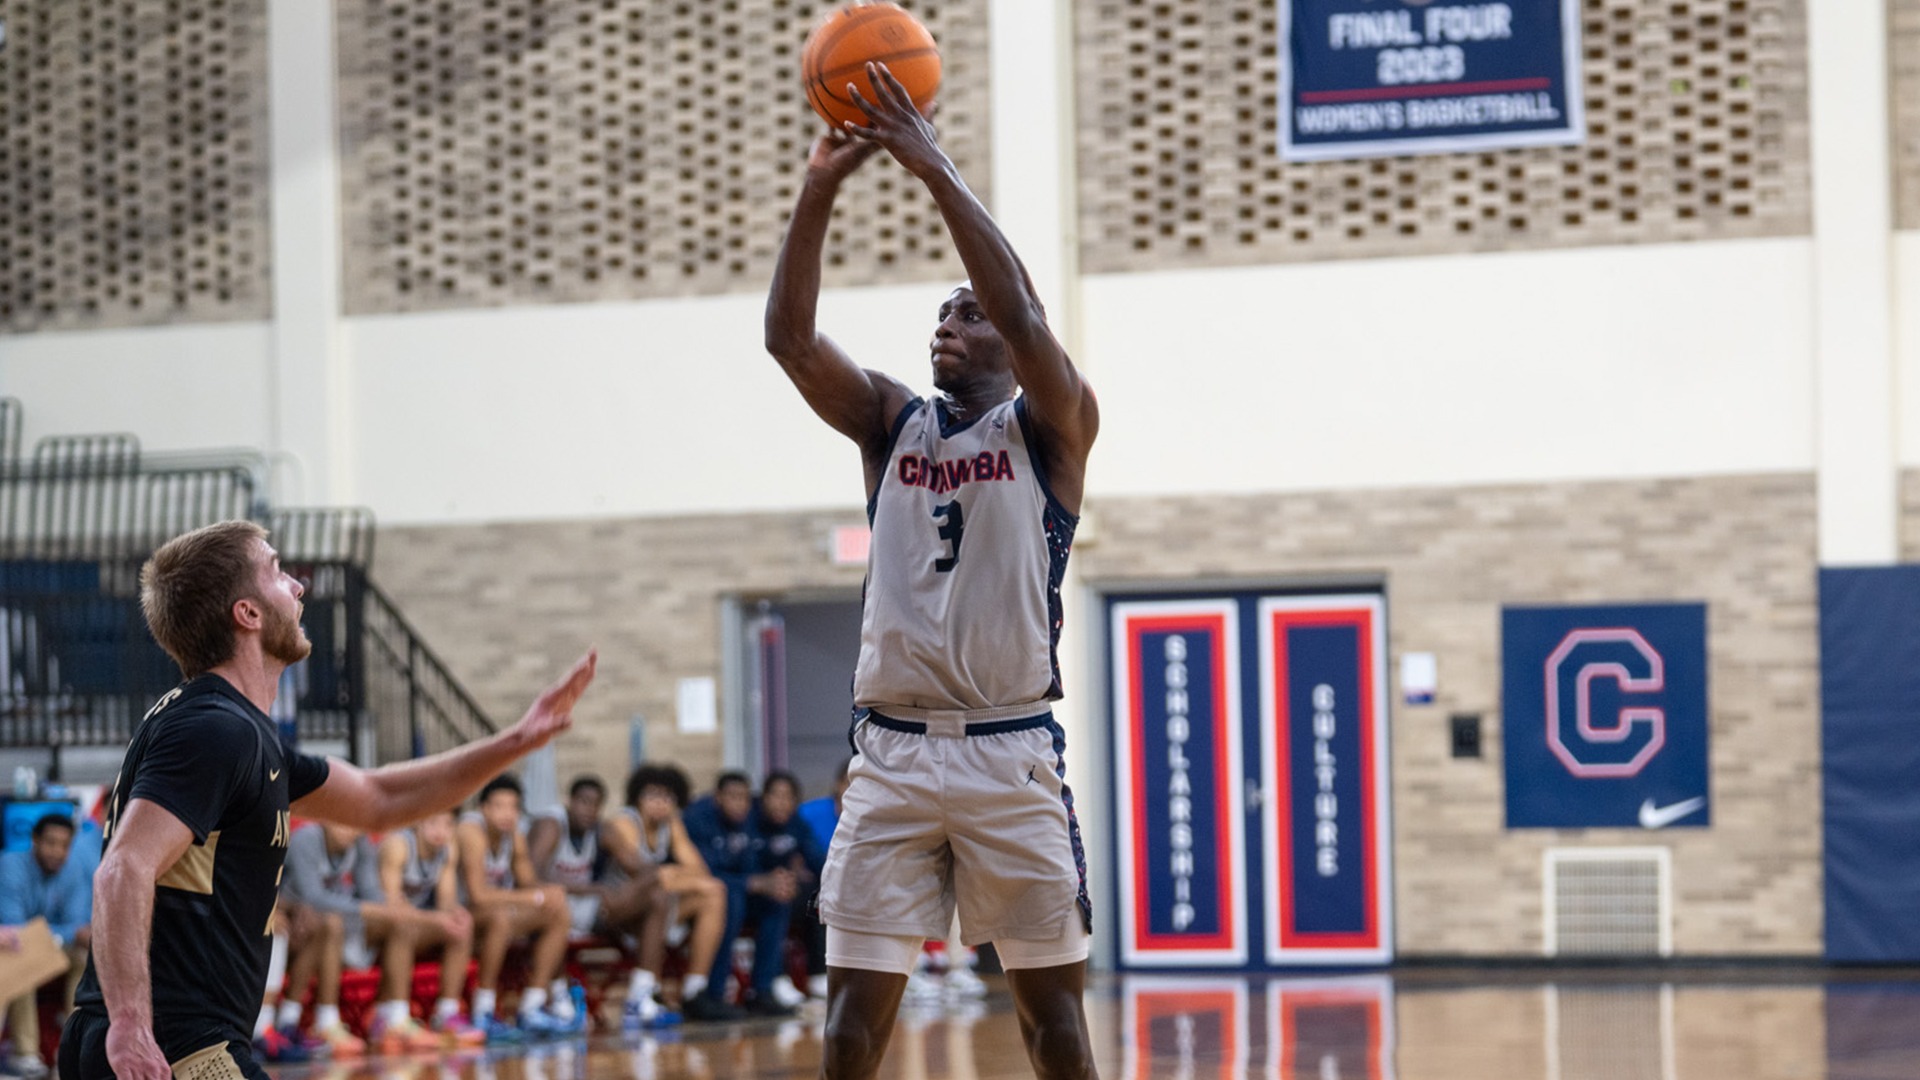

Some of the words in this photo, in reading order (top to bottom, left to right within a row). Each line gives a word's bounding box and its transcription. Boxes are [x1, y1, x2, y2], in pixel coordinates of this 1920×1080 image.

[1328, 9, 1422, 49] FINAL
[1425, 3, 1512, 43] FOUR
[1377, 44, 1465, 85] 2023
[1298, 100, 1405, 133] WOMEN'S
[1406, 92, 1560, 128] BASKETBALL
[932, 499, 964, 573] 3
[1545, 627, 1665, 778] C
[1164, 634, 1195, 931] SCHOLARSHIP
[1312, 683, 1339, 877] CULTURE
